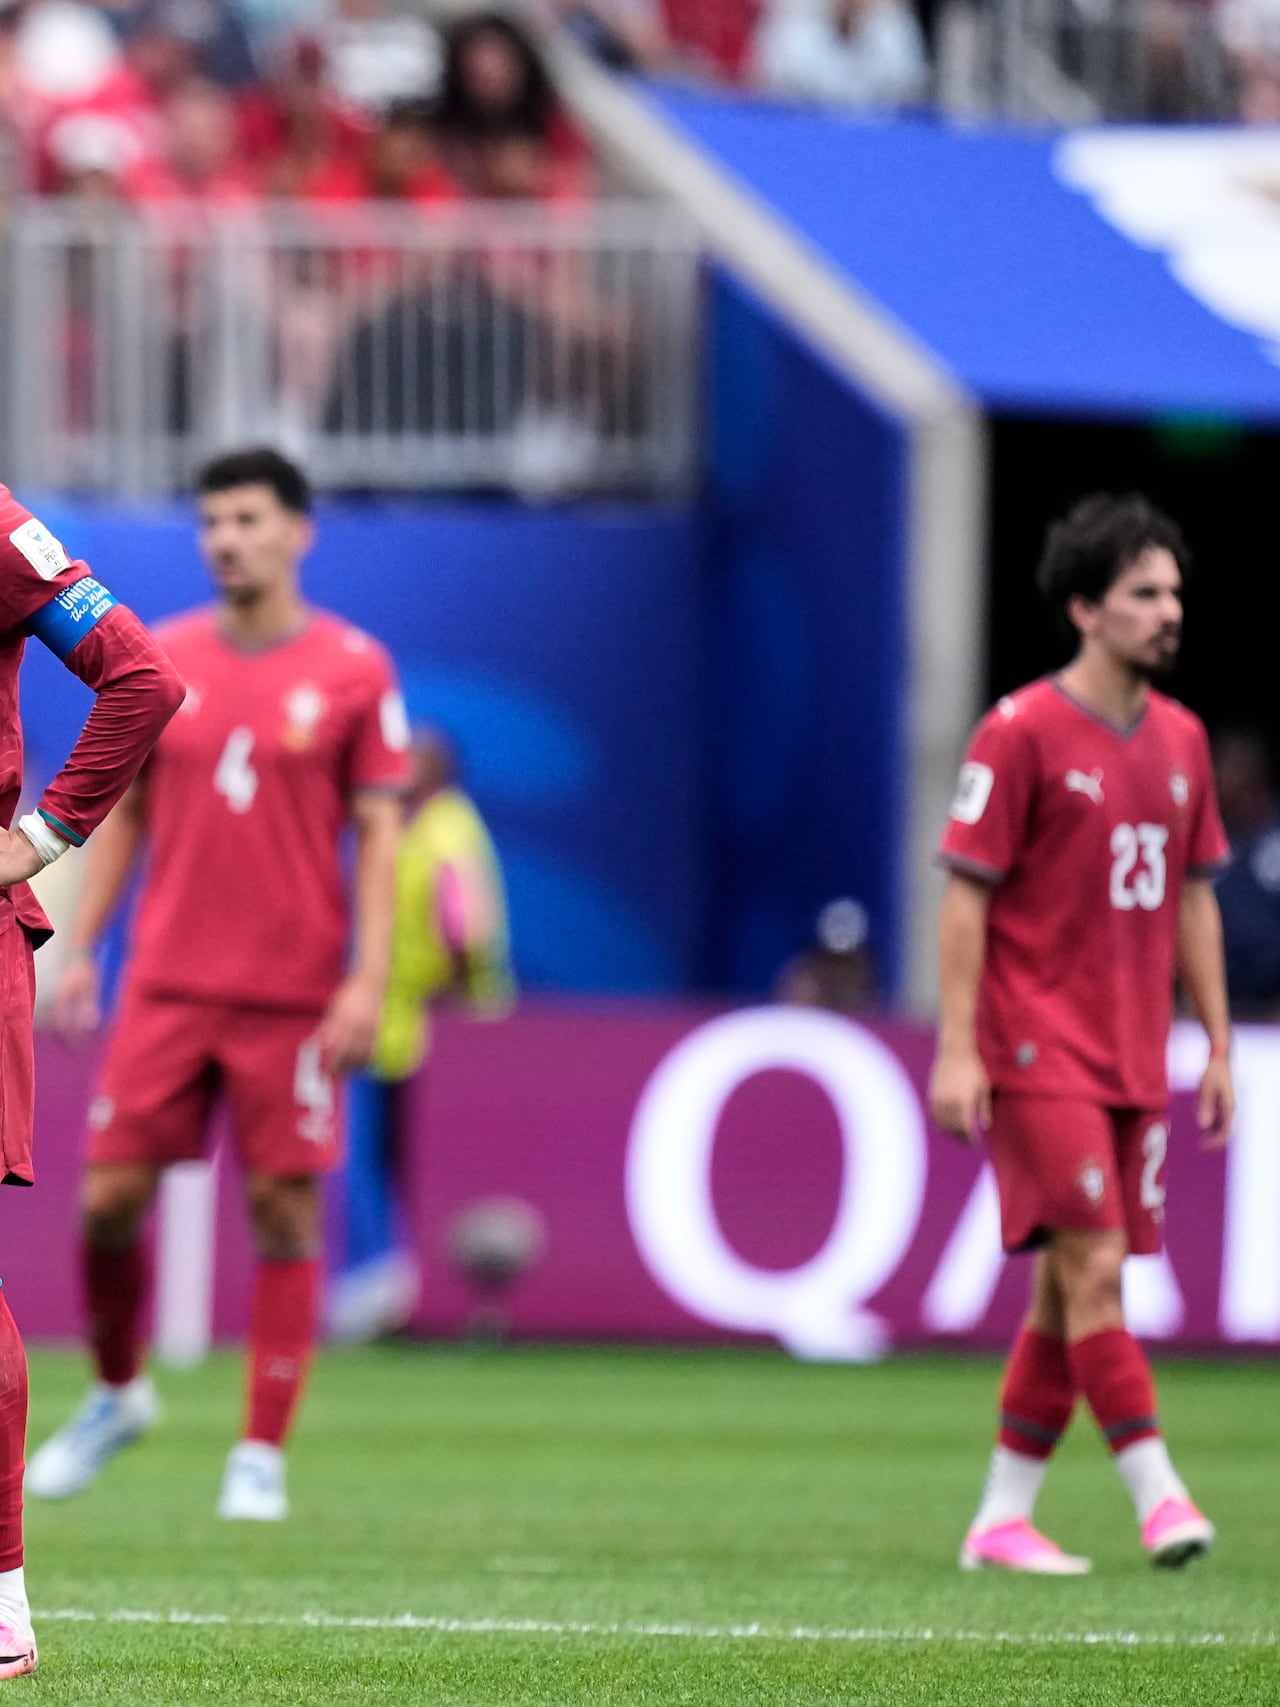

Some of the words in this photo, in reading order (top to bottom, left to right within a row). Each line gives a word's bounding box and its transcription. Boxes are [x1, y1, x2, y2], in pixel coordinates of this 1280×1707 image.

[70, 604, 89, 622] the
[214, 727, 258, 813] 4
[1110, 822, 1169, 911] 23
